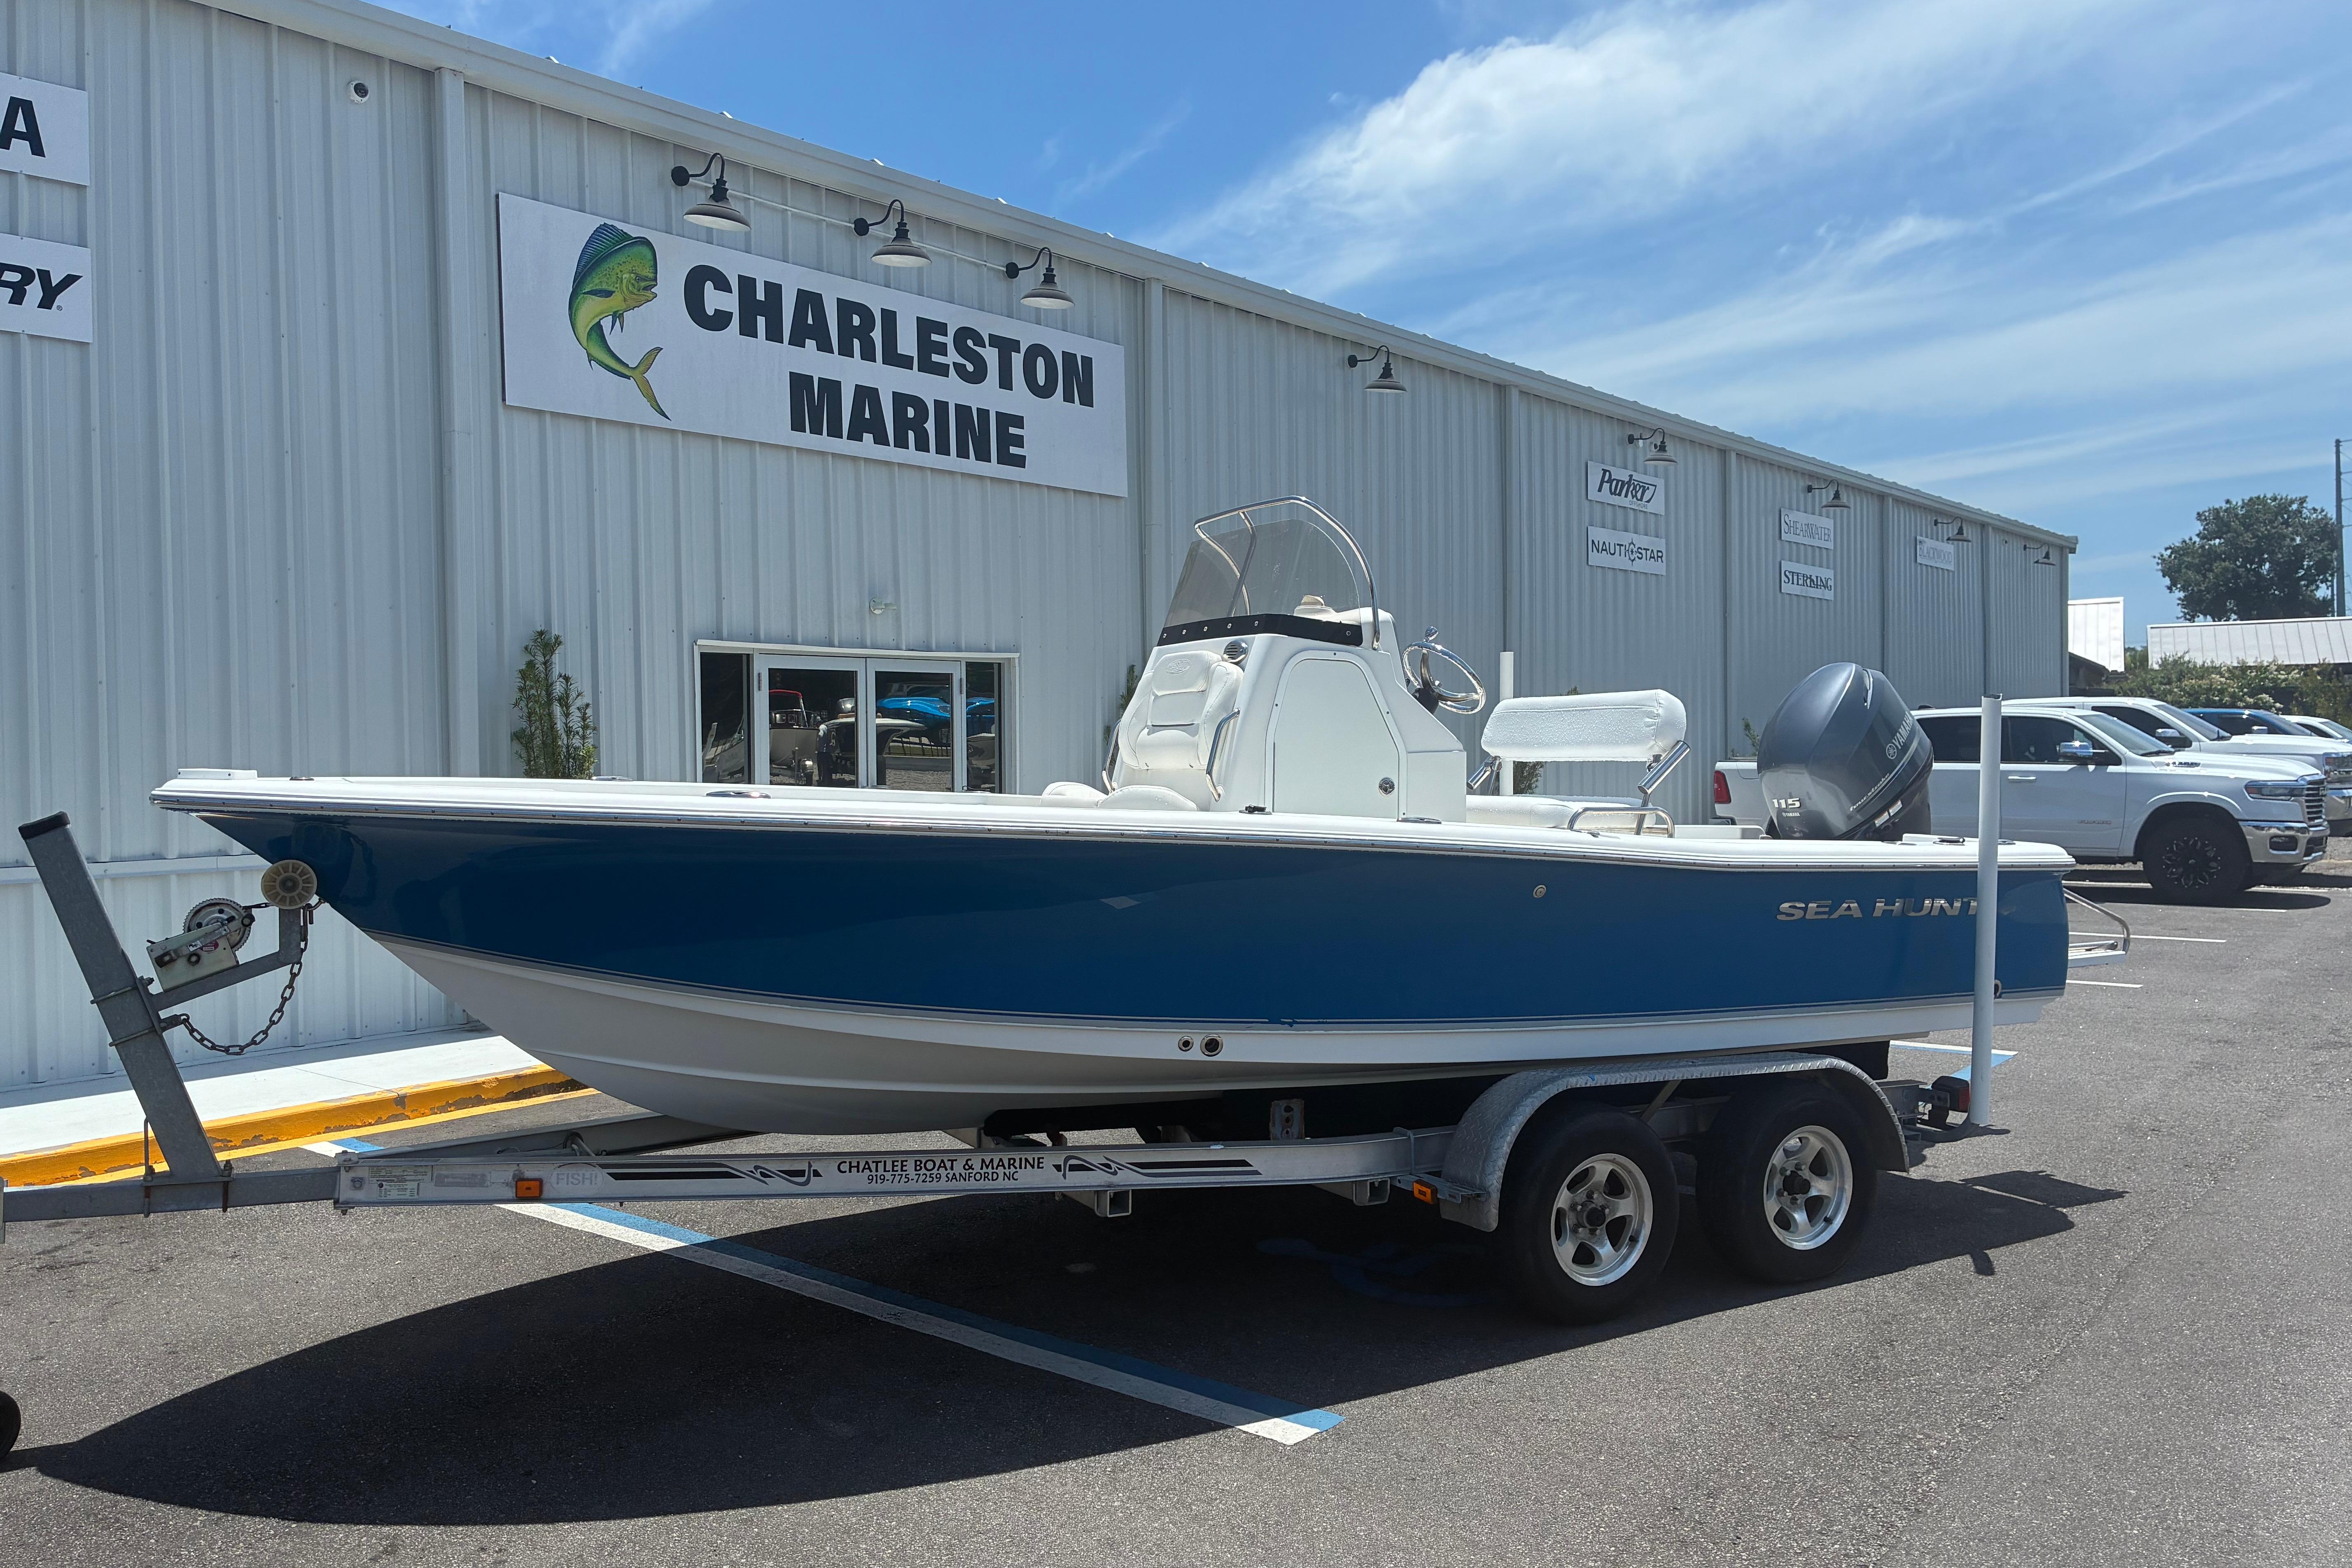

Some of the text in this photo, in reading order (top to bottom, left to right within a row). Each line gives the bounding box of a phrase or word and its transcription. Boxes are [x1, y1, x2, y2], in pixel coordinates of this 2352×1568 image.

[684, 264, 1094, 408] CHARLESTON
[789, 371, 1027, 469] MARINE
[1598, 468, 1657, 503] Parker
[1629, 500, 1648, 509] OFFSHORE
[1784, 569, 1832, 591] STERLING
[1892, 711, 1913, 749] YAMAHA
[1772, 798, 1800, 808] 115
[1777, 900, 1862, 921] SEA
[837, 1157, 1044, 1174] CHATLEE BOAT & MARINE
[556, 1172, 597, 1185] FISH!
[867, 1171, 1018, 1184] 919-775-7259 SANFORD NC
